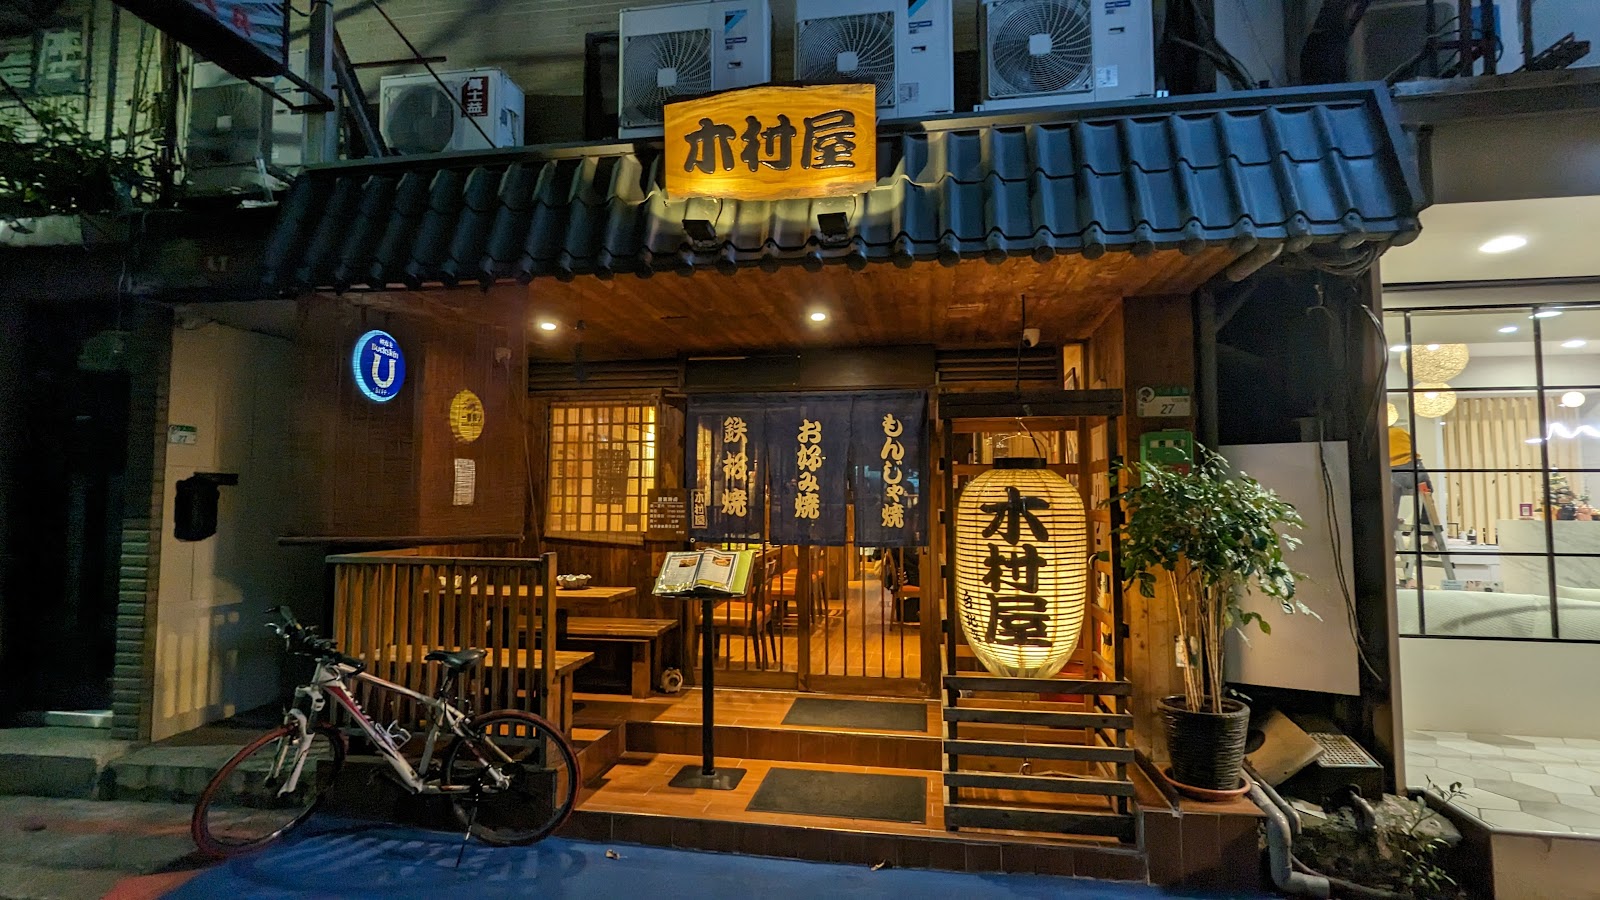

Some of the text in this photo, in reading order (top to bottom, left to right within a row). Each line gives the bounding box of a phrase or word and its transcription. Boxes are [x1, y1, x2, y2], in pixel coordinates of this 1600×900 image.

[684, 109, 856, 174] 木村屋
[1160, 404, 1175, 414] 27
[694, 491, 706, 526] 木村屋
[721, 416, 748, 517] 鉄板焼
[794, 418, 822, 519] お好み焼
[880, 413, 905, 529] もんじゃ焼
[980, 486, 1053, 647] 木村屋
